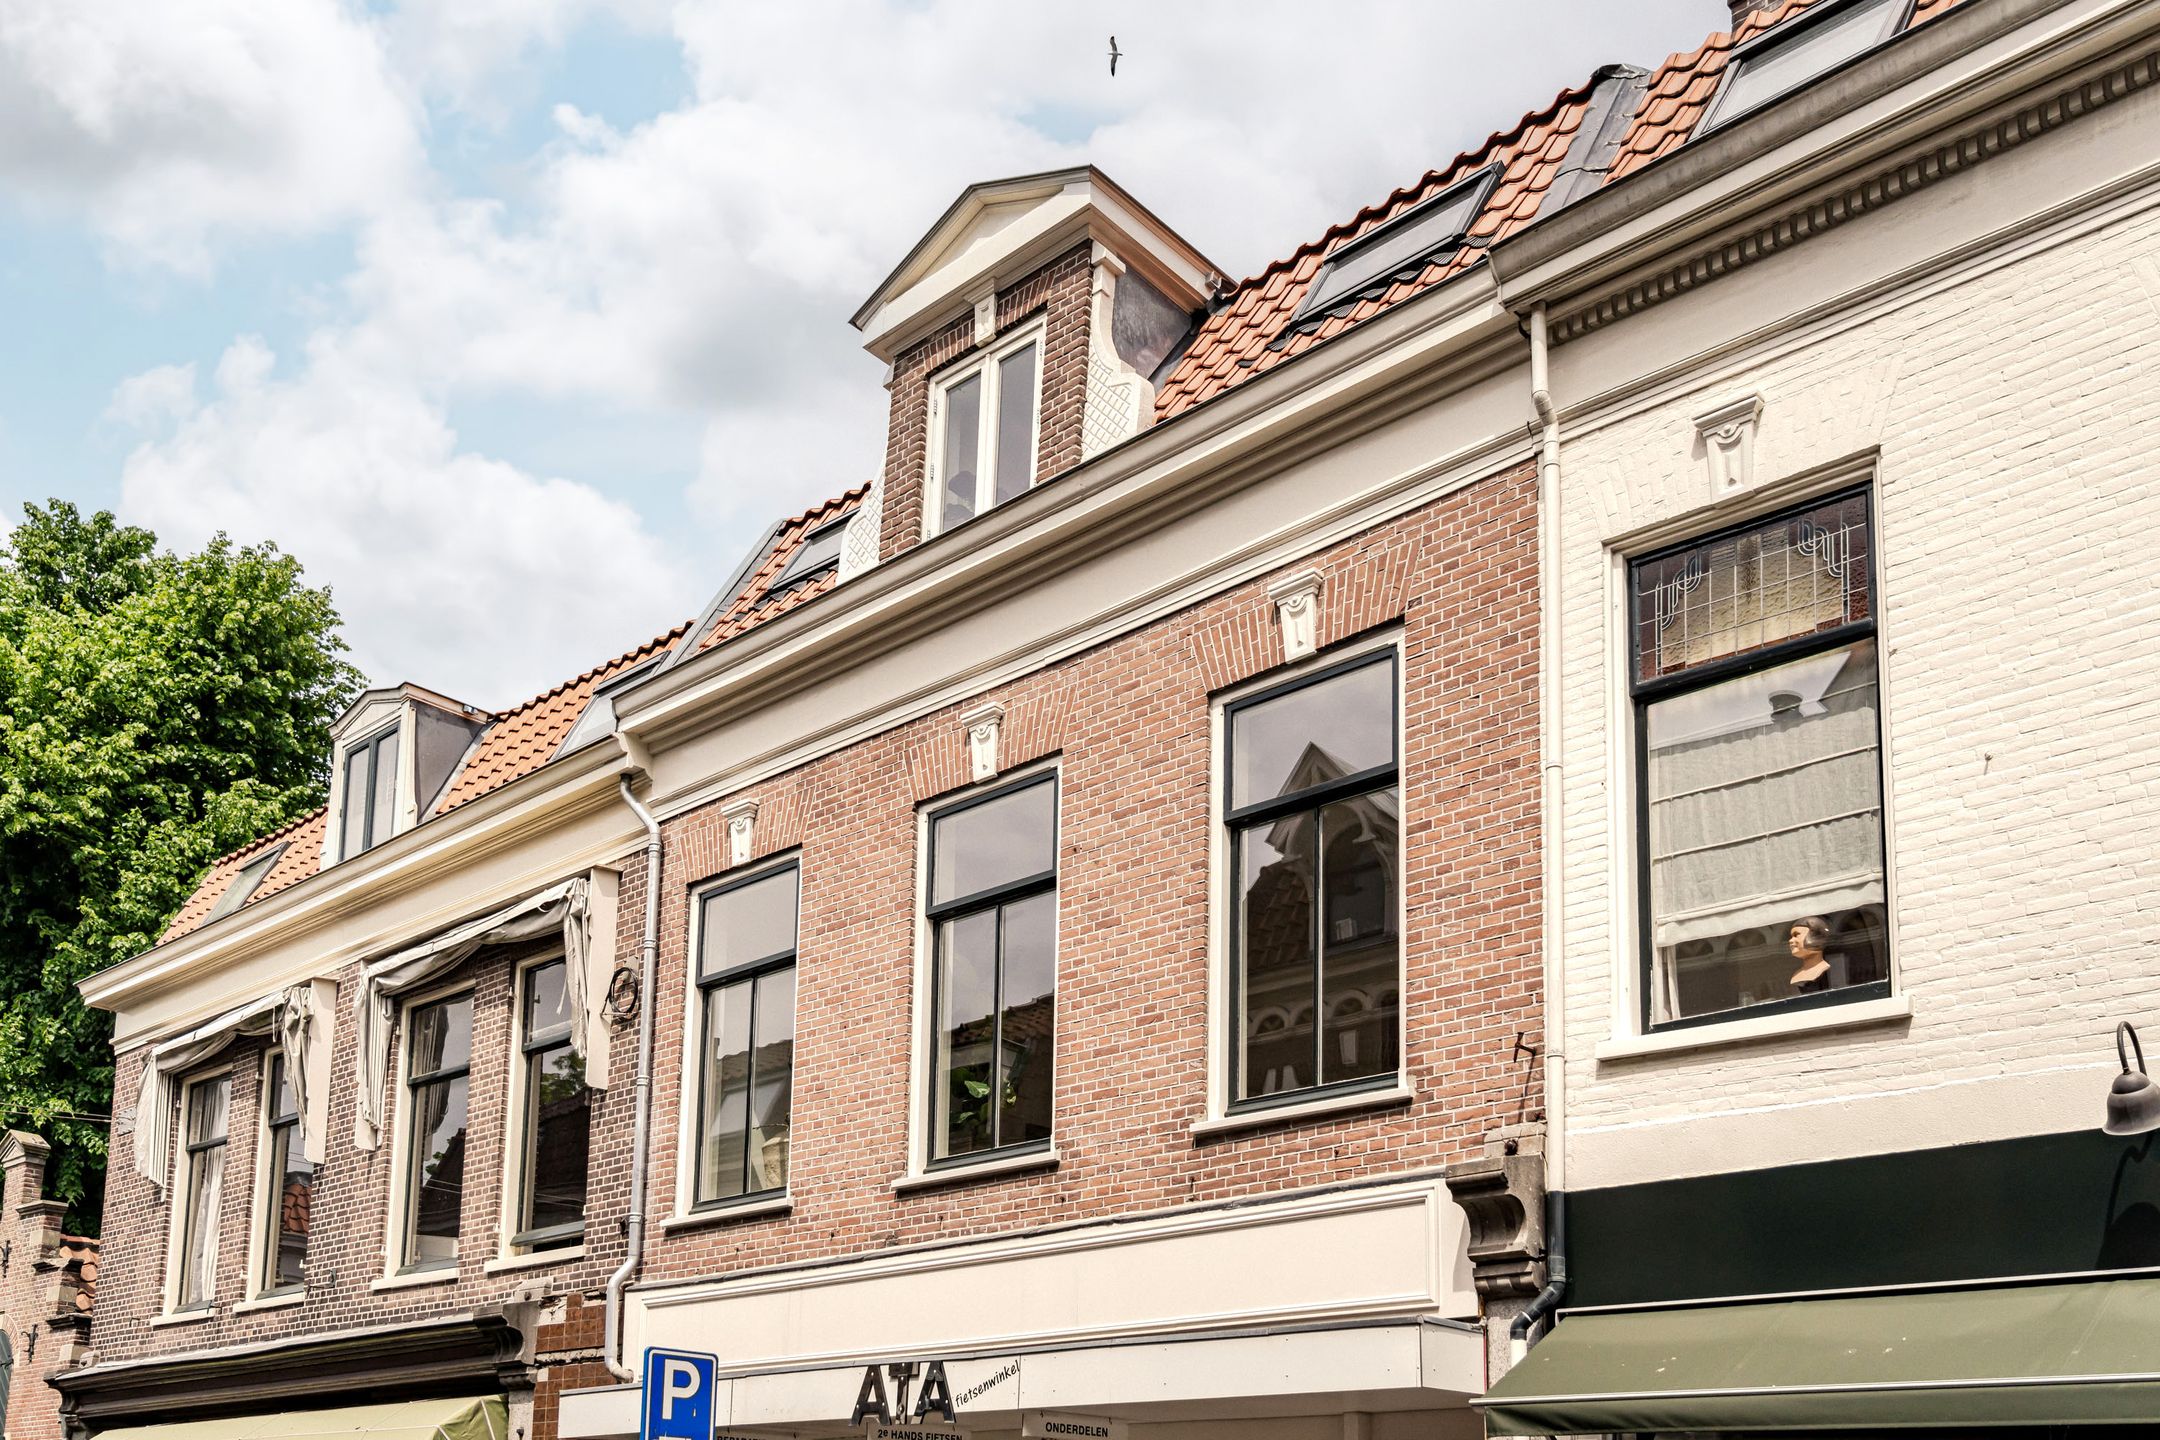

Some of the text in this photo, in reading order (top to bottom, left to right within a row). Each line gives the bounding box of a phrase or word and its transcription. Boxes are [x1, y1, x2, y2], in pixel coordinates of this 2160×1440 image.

[662, 1359, 701, 1420] P
[850, 1360, 957, 1426] ATA
[954, 1359, 1021, 1408] fietsenwinkel
[891, 1430, 923, 1440] HANDS
[1045, 1422, 1109, 1438] ONDERDELEN
